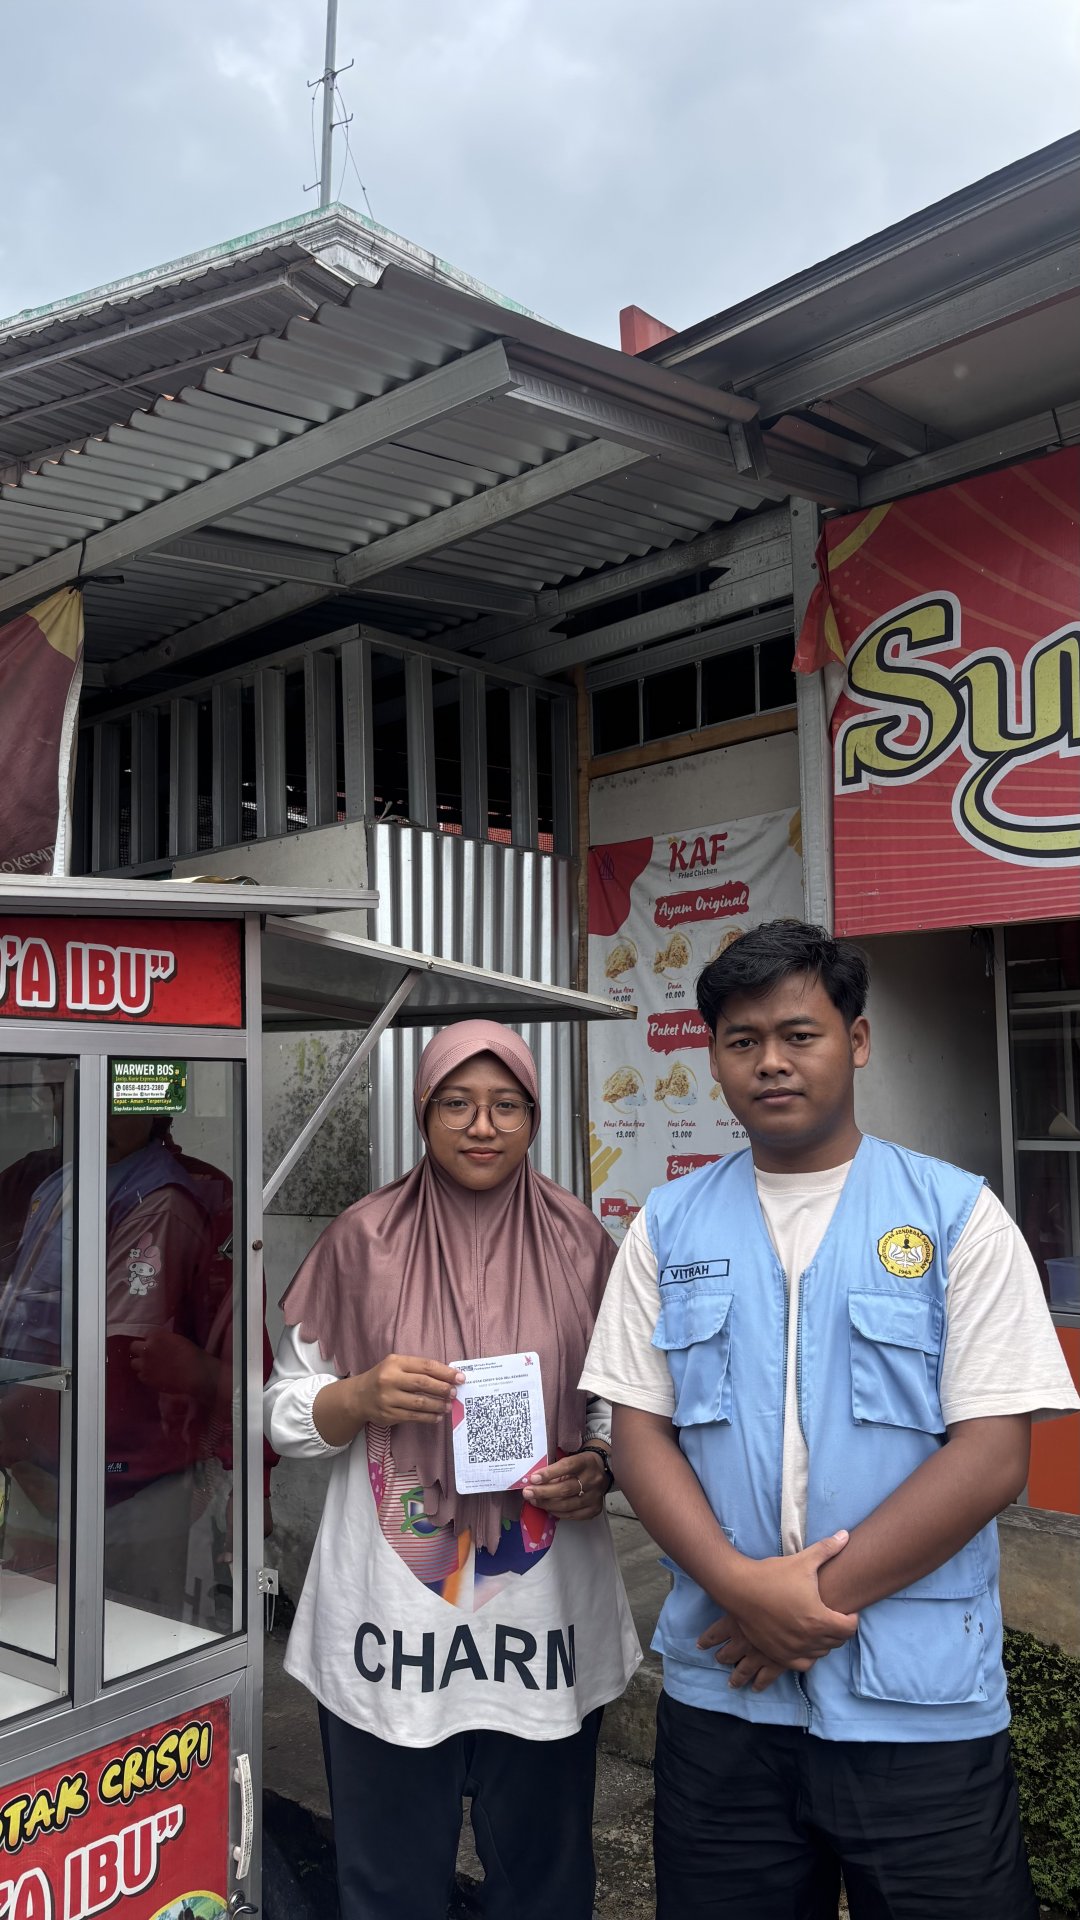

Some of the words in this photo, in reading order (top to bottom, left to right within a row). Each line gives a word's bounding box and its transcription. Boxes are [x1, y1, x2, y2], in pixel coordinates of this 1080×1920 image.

[836, 592, 1080, 860] Su
[669, 832, 728, 872] KAF
[678, 871, 693, 879] Fried
[694, 868, 718, 877] Chicken
[659, 902, 692, 920] Ayam
[695, 890, 747, 914] Original
[0, 935, 56, 1008] 'A
[650, 1022, 679, 1036] Paket
[682, 1020, 707, 1035] Nasi
[114, 1063, 155, 1076] WARWER
[156, 1064, 174, 1076] BOS
[671, 1160, 700, 1175] Serb
[608, 1204, 621, 1213] KAF
[670, 1264, 709, 1280] VITRAH
[0, 1771, 90, 1853] TAK
[98, 1720, 213, 1805] CRISPI
